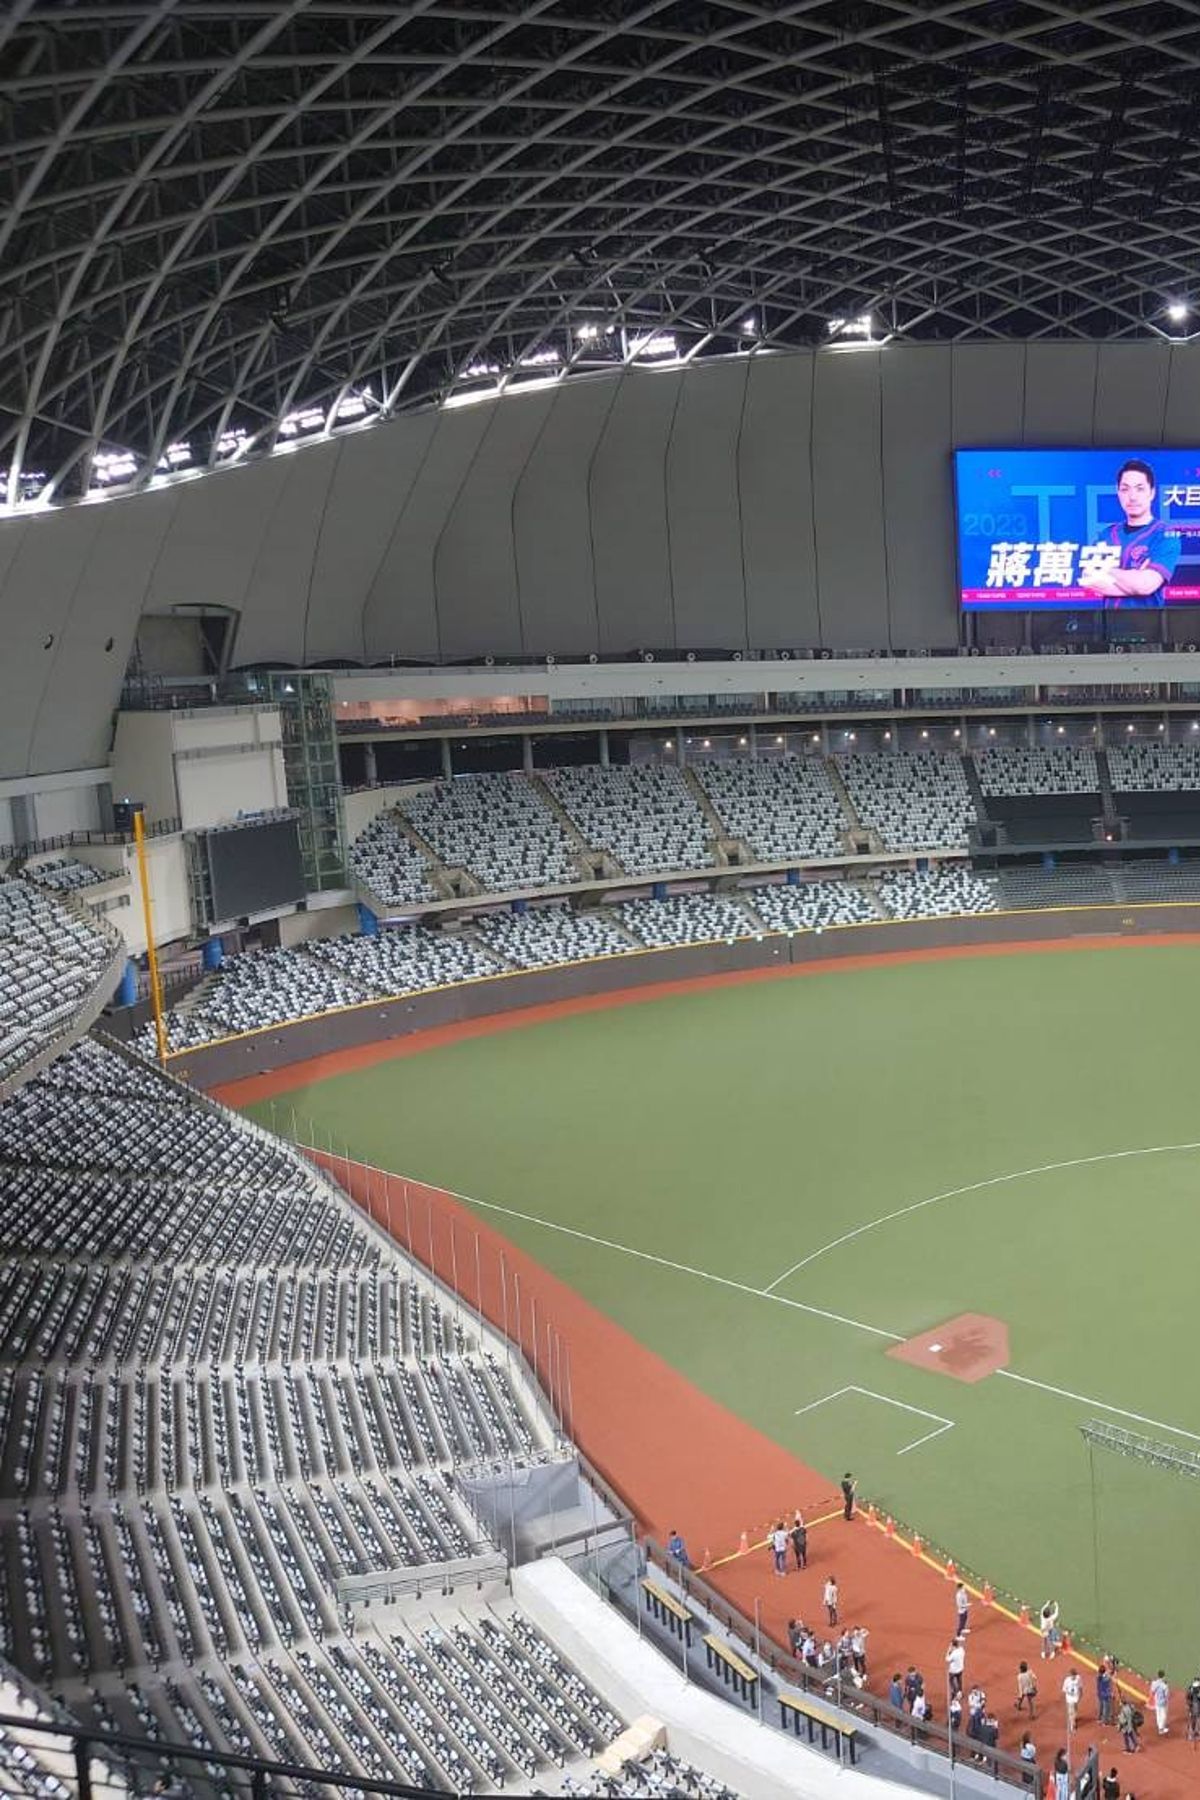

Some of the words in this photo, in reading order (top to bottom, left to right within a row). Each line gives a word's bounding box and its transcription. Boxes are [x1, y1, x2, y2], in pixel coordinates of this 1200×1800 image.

[964, 513, 1027, 536] 2023
[986, 542, 1122, 587] 蔣萬安
